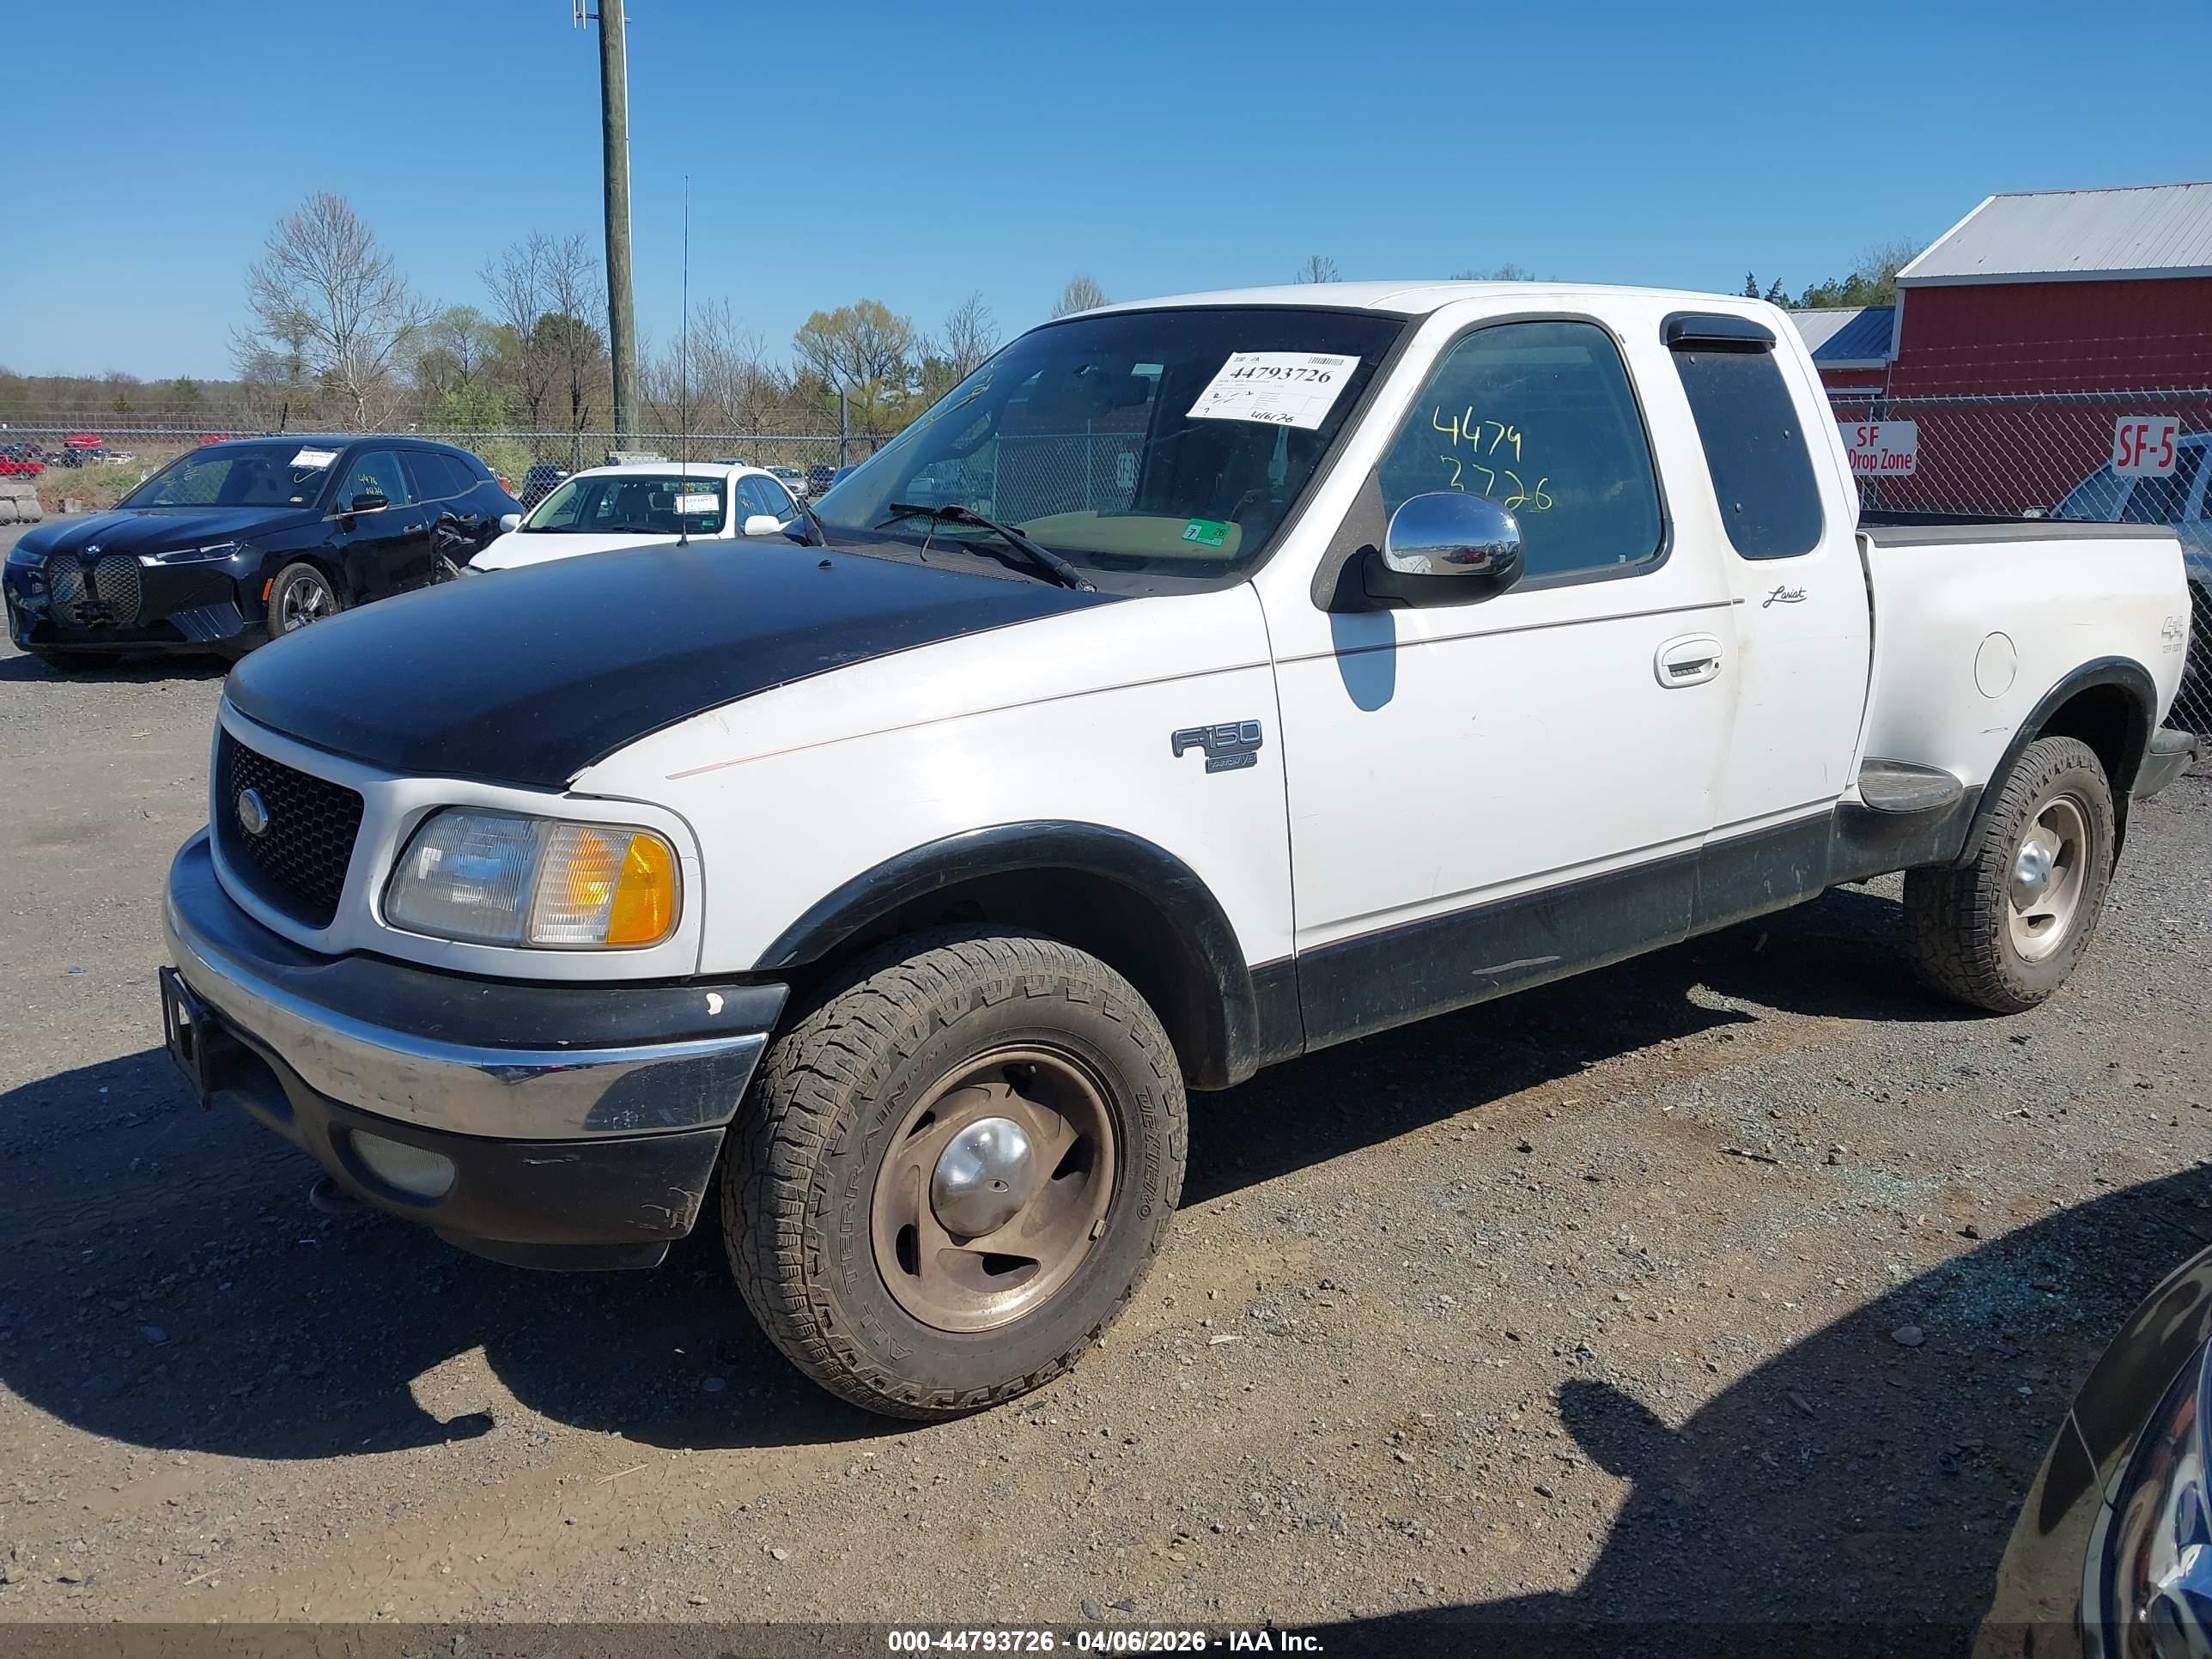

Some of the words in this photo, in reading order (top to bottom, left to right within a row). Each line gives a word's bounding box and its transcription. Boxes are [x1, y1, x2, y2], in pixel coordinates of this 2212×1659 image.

[1231, 366, 1334, 384] 44793726
[1432, 405, 1523, 464] 4479
[1856, 426, 1880, 447] SF
[2117, 423, 2176, 469] SF-5
[1849, 448, 1878, 471] Drop
[1881, 448, 1913, 471] Zone
[1440, 454, 1553, 511] 3726
[1188, 528, 1197, 538] 7
[1213, 527, 1226, 537] 26
[1762, 585, 1808, 609] Lariat
[1136, 1085, 1161, 1222] DEXTERO
[839, 1080, 908, 1295] TERRAIN
[860, 1302, 915, 1361] ALL
